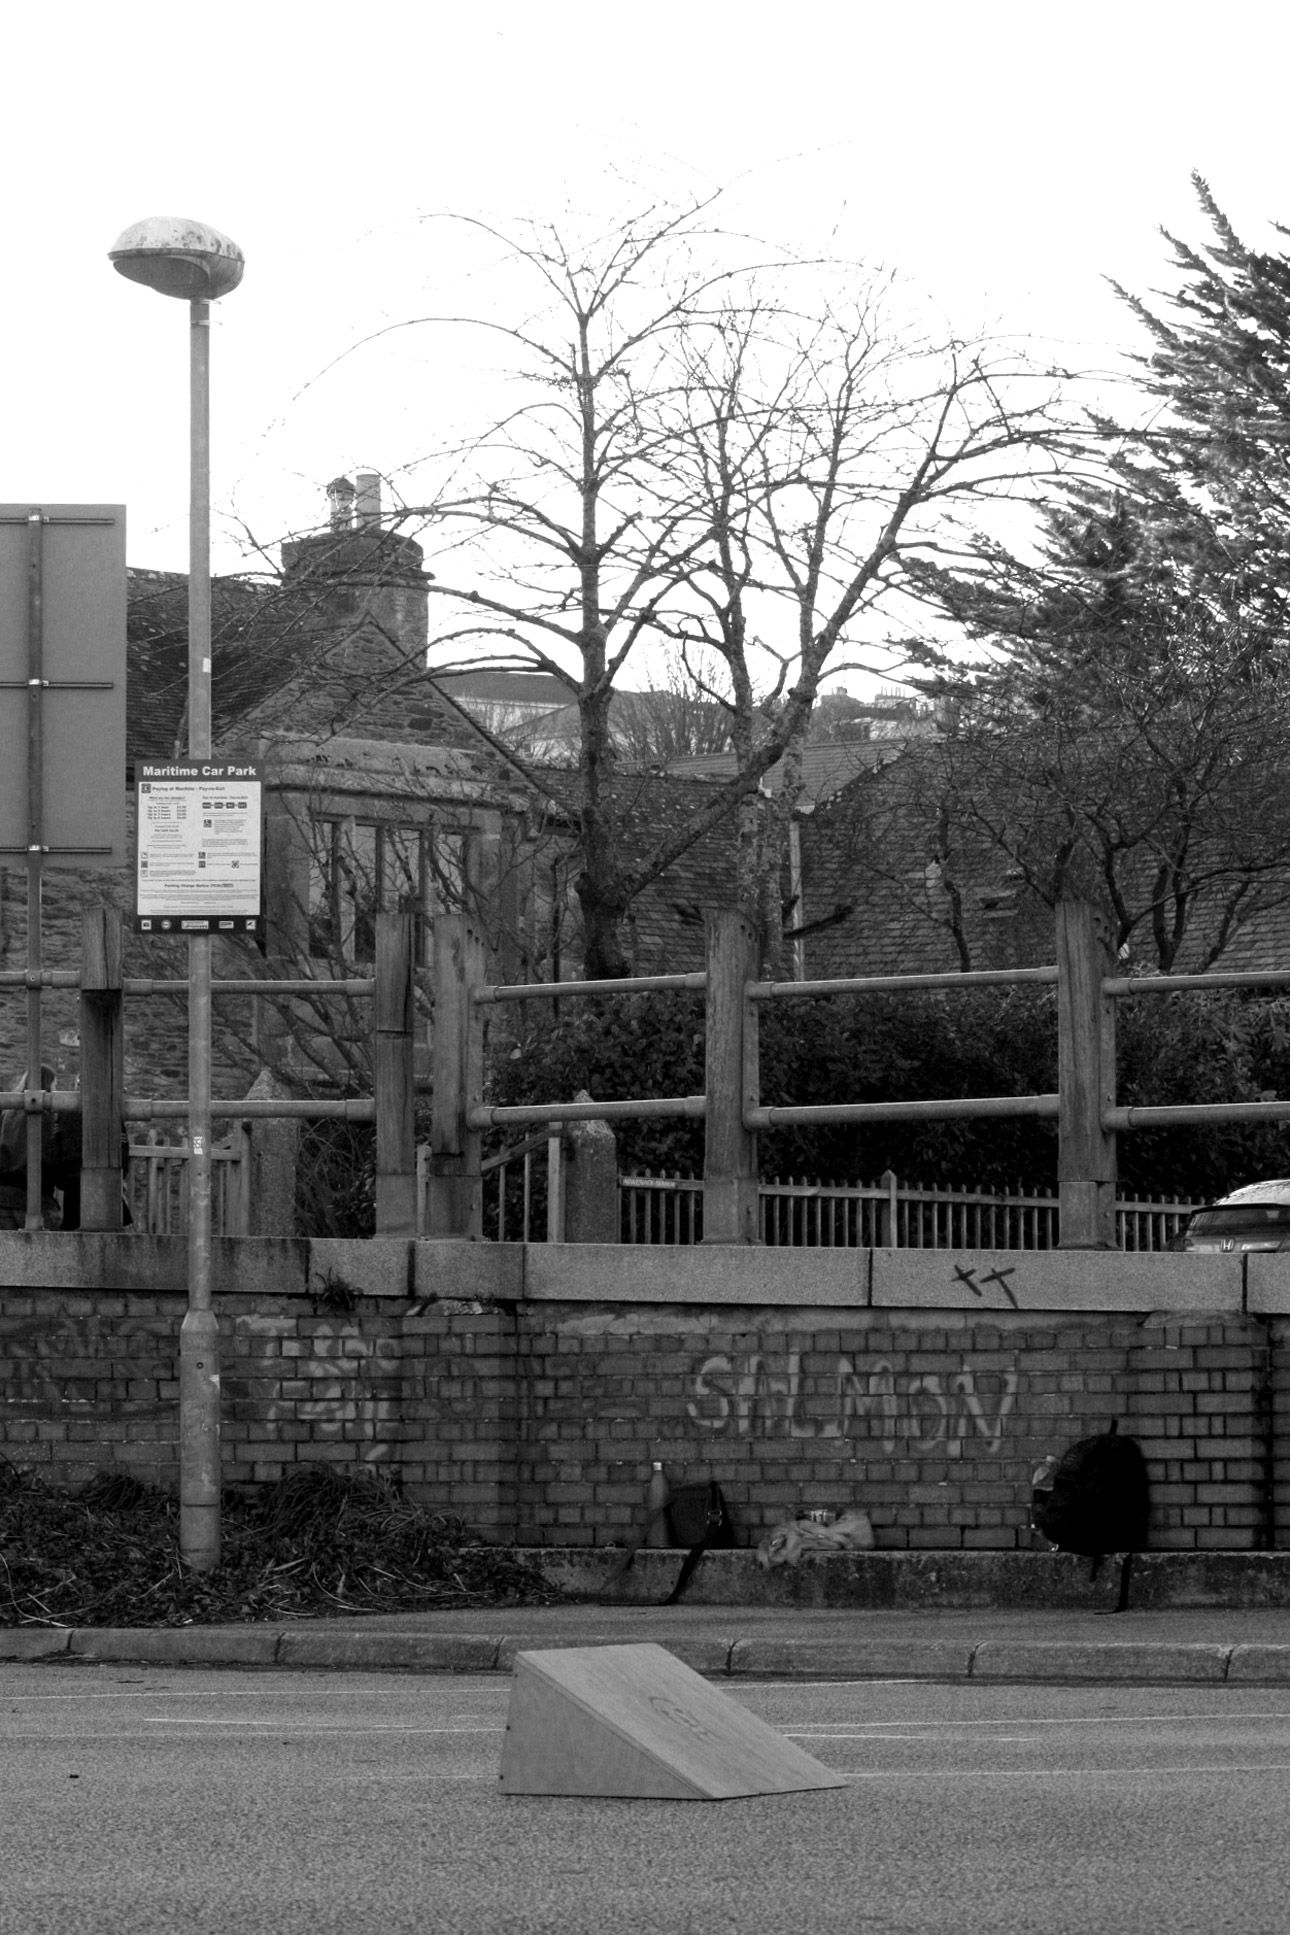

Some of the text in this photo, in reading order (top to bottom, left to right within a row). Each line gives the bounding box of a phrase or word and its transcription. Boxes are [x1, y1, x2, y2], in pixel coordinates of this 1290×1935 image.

[143, 766, 257, 776] Maritime Car Park
